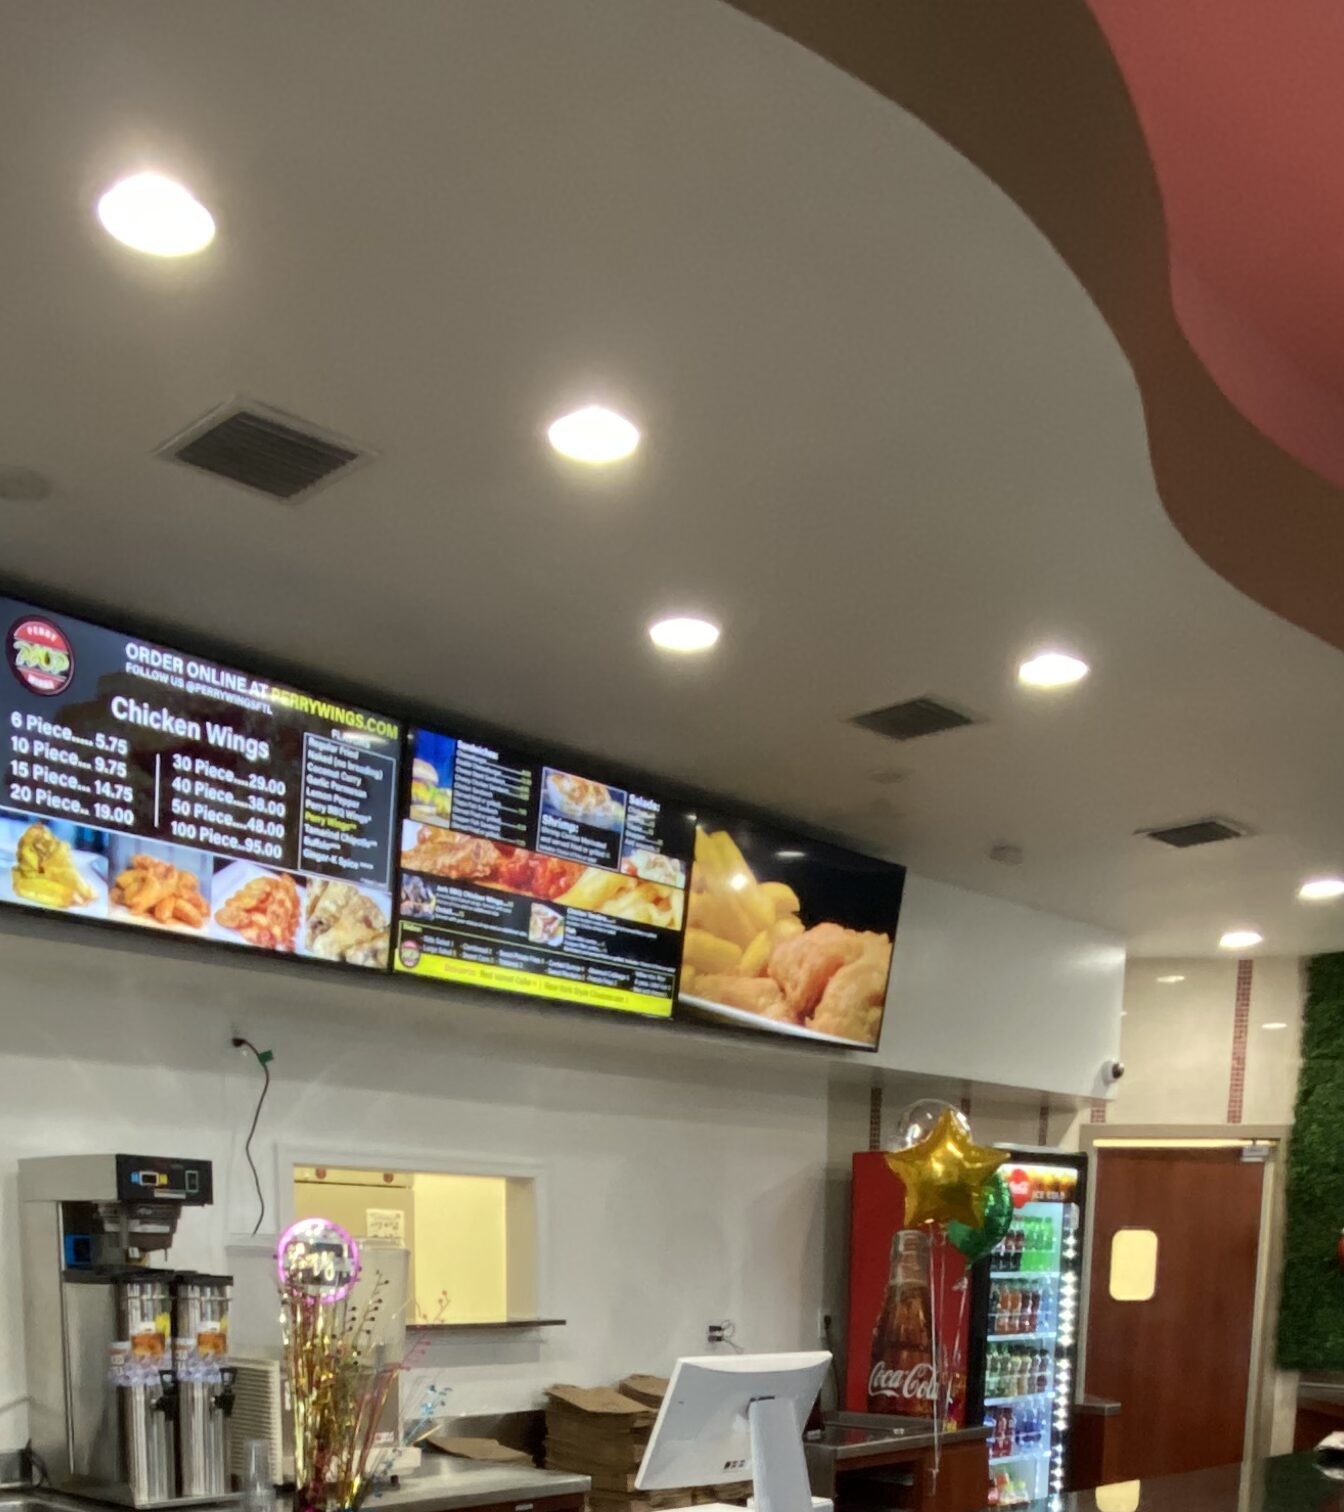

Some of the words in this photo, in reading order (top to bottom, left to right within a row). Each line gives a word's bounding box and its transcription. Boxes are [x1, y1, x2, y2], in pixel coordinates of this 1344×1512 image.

[126, 662, 169, 685] FOLLOW
[170, 675, 184, 689] US
[126, 642, 183, 675] ORDER
[187, 661, 247, 692] ONLINE
[250, 680, 269, 697] AT
[271, 687, 398, 740] PERRYWINGS.COM
[11, 711, 22, 728] 6
[95, 733, 128, 755] 5.75
[111, 696, 201, 741] Chicken
[206, 721, 270, 761] Wings
[11, 736, 29, 754] 10
[95, 756, 127, 778] 9.75
[173, 753, 191, 771] 30
[10, 760, 29, 777] 15
[94, 780, 133, 802] 14.75
[172, 776, 191, 793] 40
[10, 783, 31, 802] 20
[94, 803, 134, 825] 19.00
[172, 798, 190, 816] 50
[171, 821, 196, 839] 100
